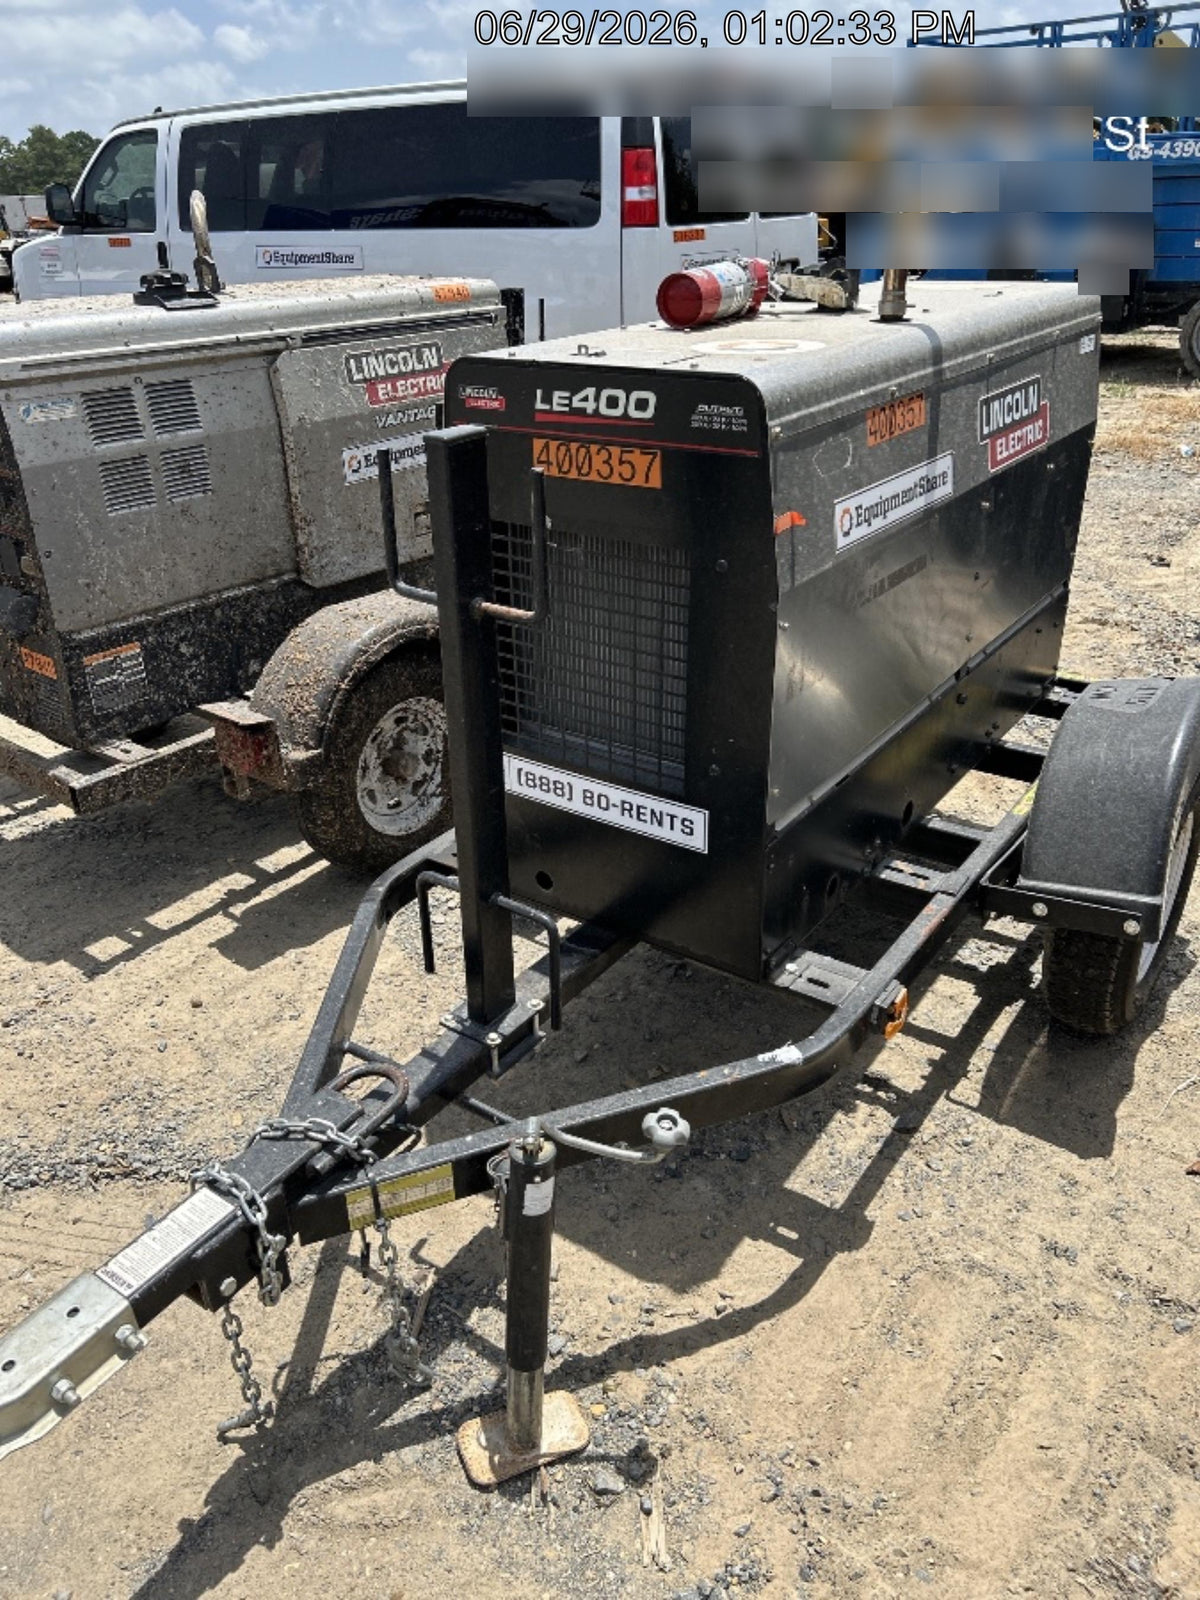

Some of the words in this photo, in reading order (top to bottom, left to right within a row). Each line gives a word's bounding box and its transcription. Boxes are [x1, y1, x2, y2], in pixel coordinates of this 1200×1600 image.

[273, 251, 355, 266] EquipmentShare
[350, 346, 439, 381] LINCOLN
[375, 405, 436, 429] VANTAG
[534, 386, 657, 419] LE400
[868, 392, 925, 443] 400357
[982, 383, 1038, 435] LINCOLN
[996, 419, 1043, 462] ELECTRIC
[535, 439, 660, 485] 400357
[854, 470, 949, 528] EquipmentShare
[516, 767, 574, 802] (888)
